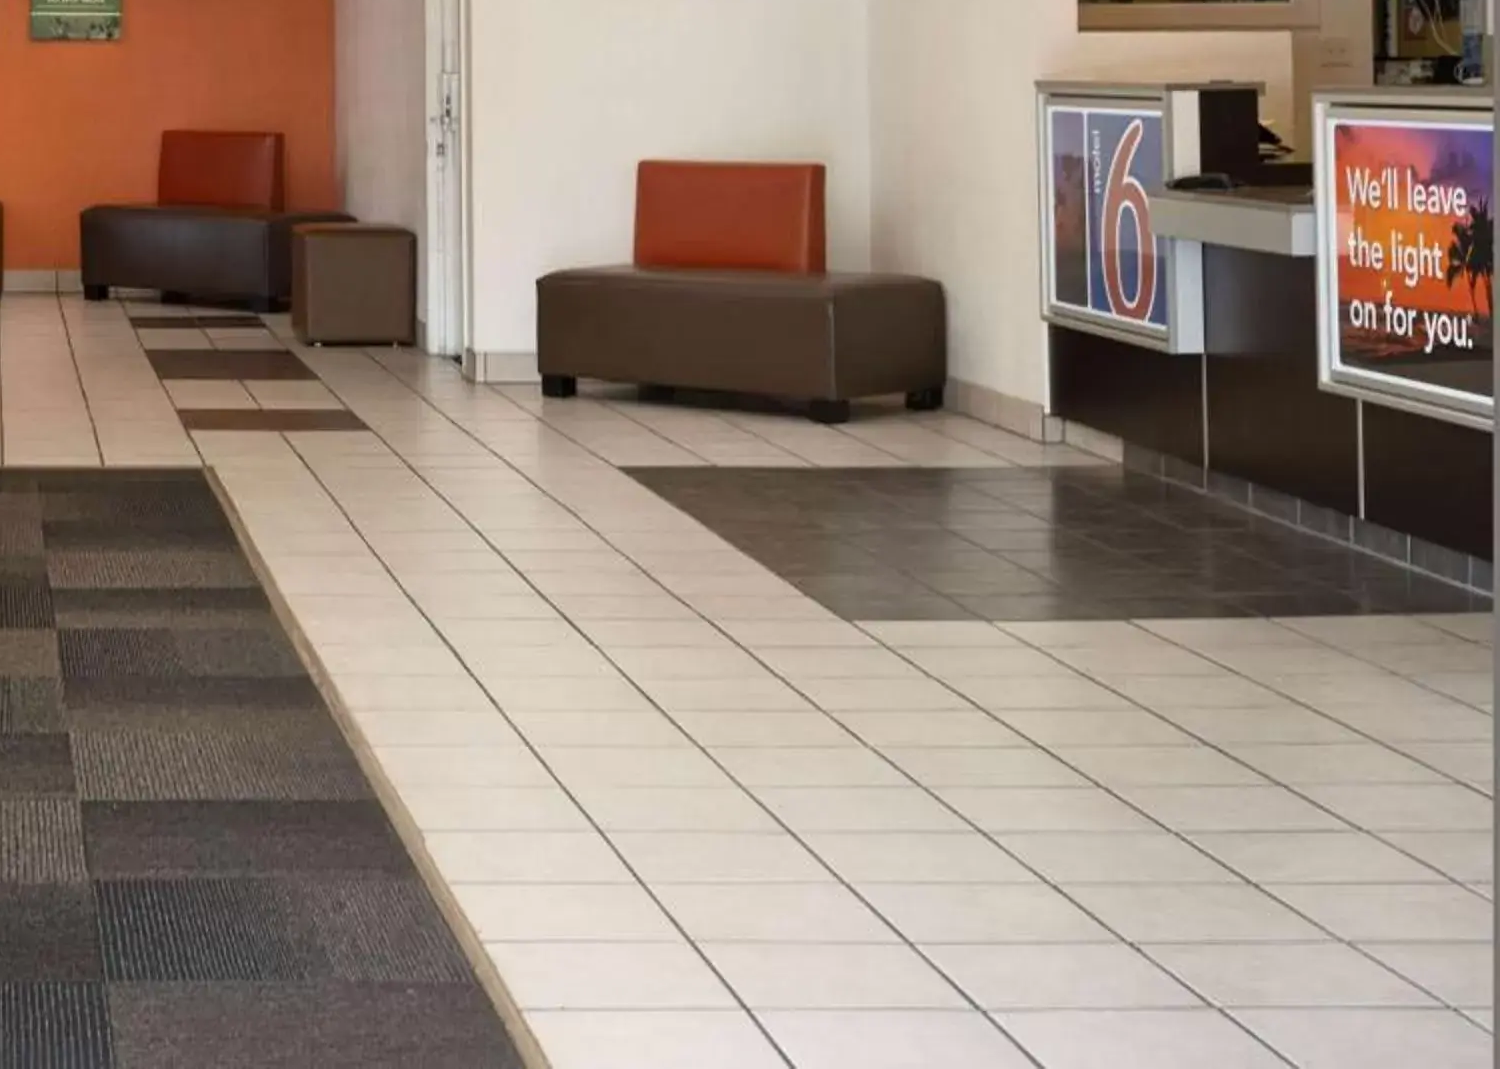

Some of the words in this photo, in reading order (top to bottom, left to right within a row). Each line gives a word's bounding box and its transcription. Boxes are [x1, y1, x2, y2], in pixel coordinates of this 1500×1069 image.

[1092, 129, 1101, 193] motel
[1346, 166, 1400, 211] We'll
[1407, 169, 1468, 218] leave
[1101, 118, 1157, 323] 6
[1348, 227, 1384, 271] the
[1390, 230, 1444, 288] light
[1349, 298, 1377, 331] on
[1382, 291, 1417, 338] for
[1423, 310, 1474, 354] you.
